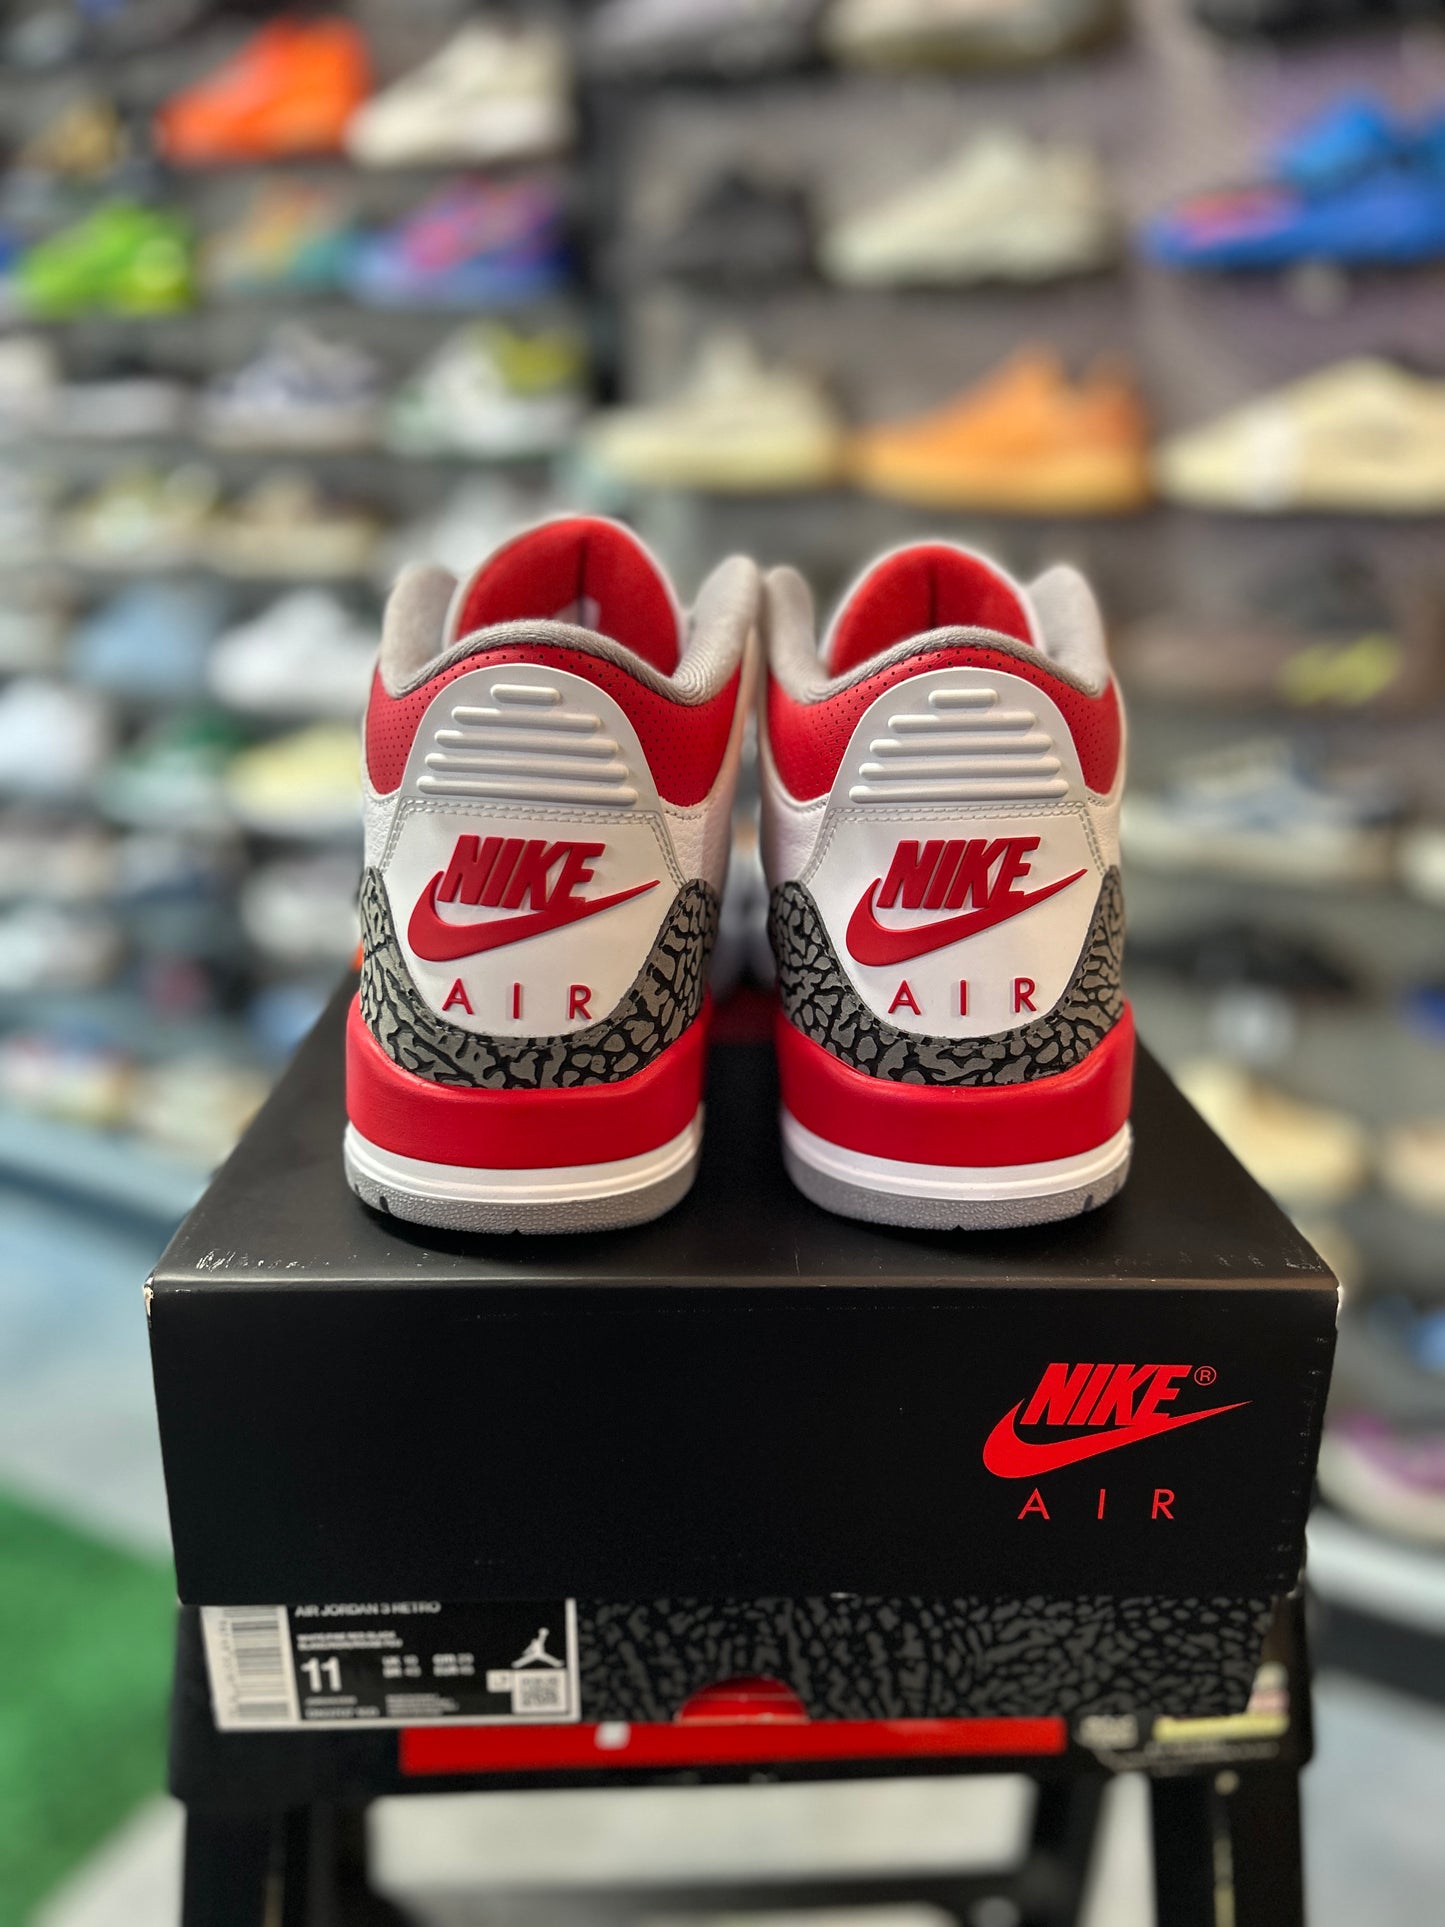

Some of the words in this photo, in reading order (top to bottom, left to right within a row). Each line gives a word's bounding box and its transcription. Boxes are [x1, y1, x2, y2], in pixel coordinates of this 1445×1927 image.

[436, 834, 606, 911] NIKE
[876, 836, 1041, 909] NIKE
[442, 977, 593, 1020] AIR
[887, 976, 1037, 1016] AIR
[1017, 1487, 1175, 1520] AIR
[294, 1604, 320, 1618] AIR
[320, 1603, 379, 1616] JORDAN
[300, 1656, 342, 1693] 11
